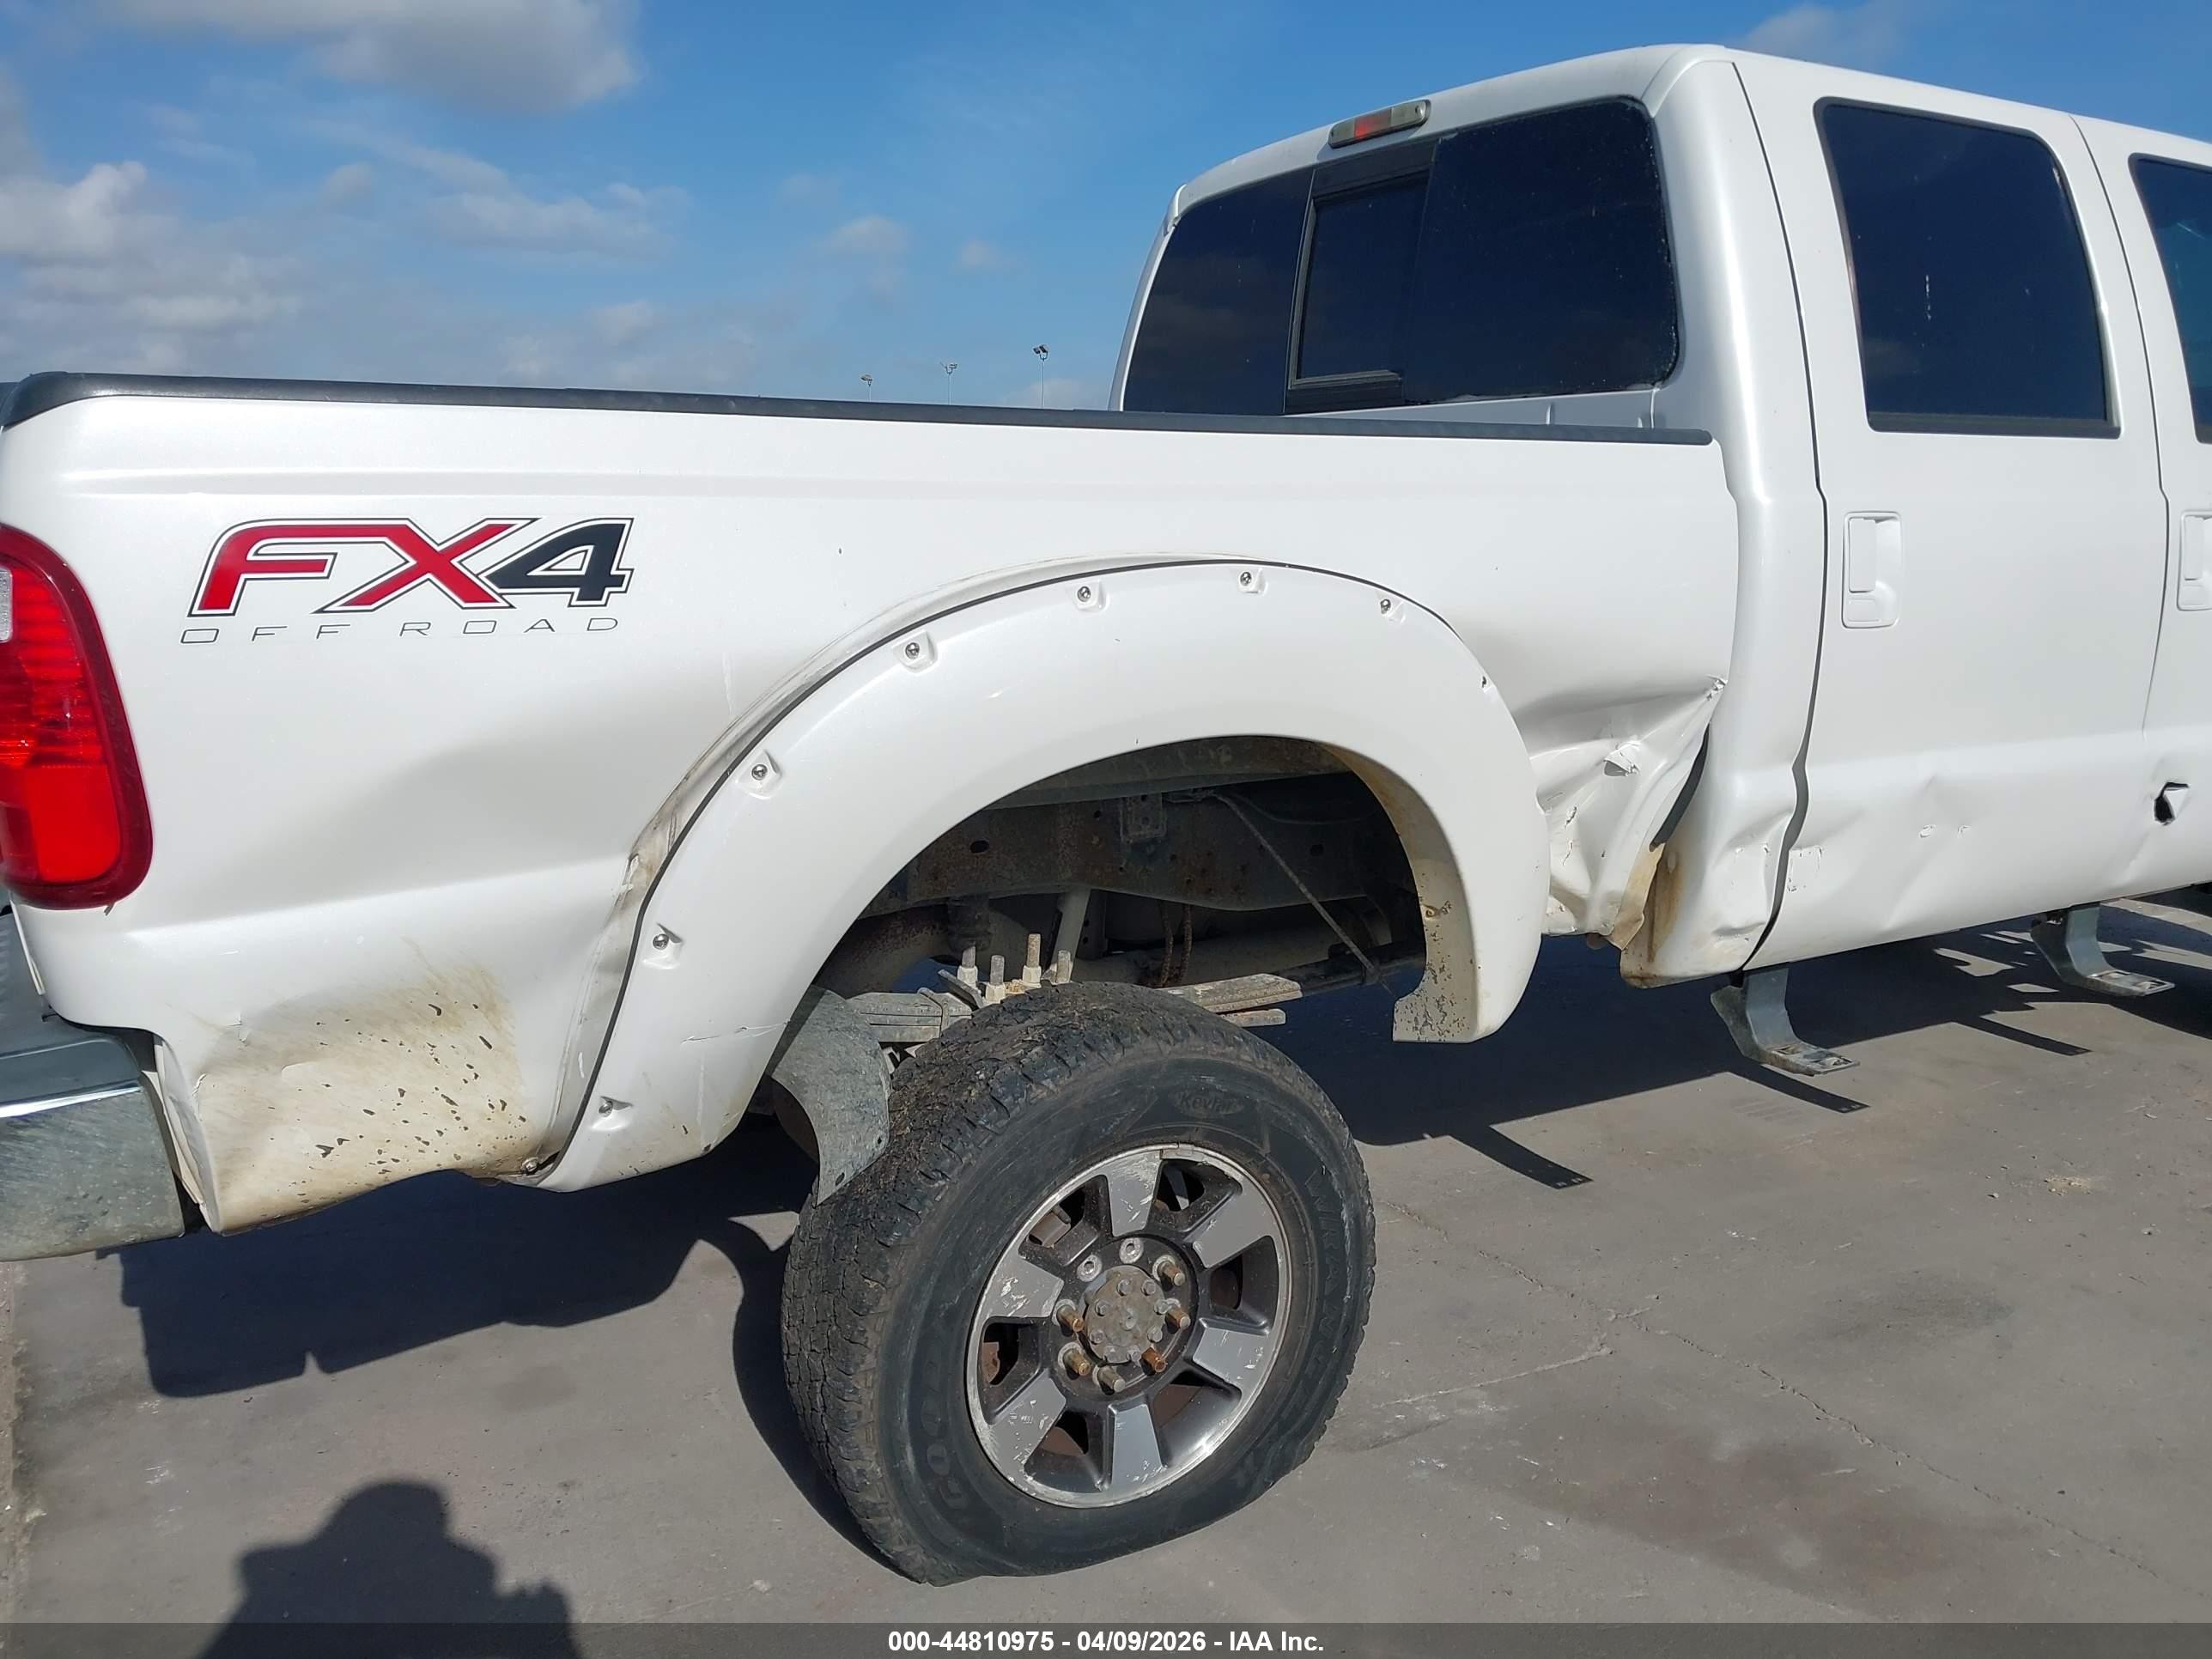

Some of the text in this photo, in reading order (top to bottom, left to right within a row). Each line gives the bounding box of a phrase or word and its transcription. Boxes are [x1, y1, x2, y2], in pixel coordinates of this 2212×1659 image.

[186, 517, 635, 617] FX4
[179, 617, 619, 645] OFF ROAD
